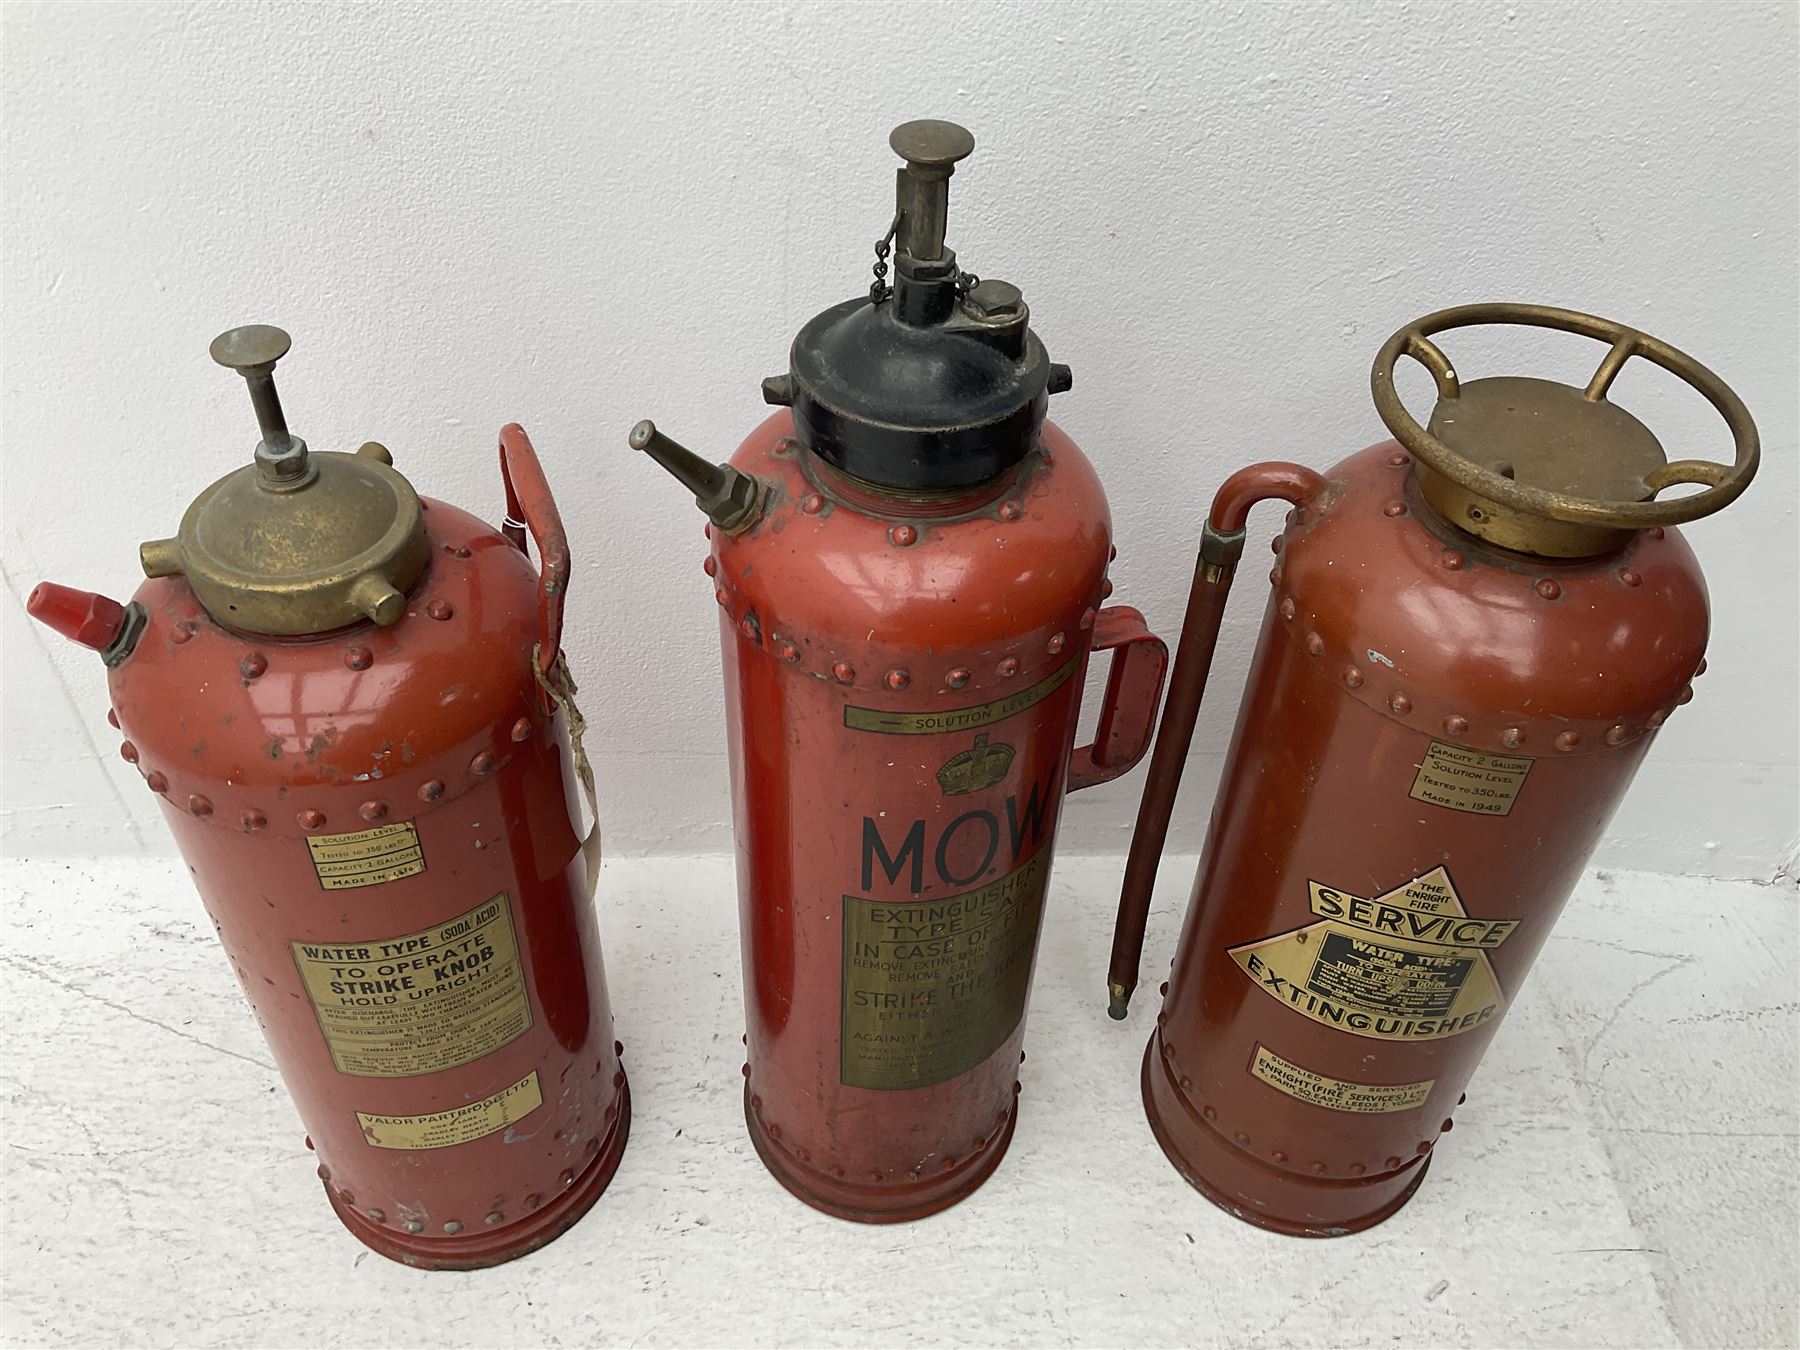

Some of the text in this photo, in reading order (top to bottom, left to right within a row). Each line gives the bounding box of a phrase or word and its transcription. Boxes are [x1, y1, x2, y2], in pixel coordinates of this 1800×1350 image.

[916, 691, 1041, 729] SOLUTION LEVEL
[1431, 745, 1528, 770] CAPACITY 2 GALLONS
[1423, 775, 1456, 791] TESTED
[1432, 761, 1515, 784] SOLUTION LEVEL
[1422, 791, 1450, 804] MADE
[1472, 802, 1502, 812] 1949
[321, 826, 397, 844] SOLUTION LEVEL
[320, 852, 349, 860] TESTED
[320, 864, 362, 873] CAPACITY
[332, 877, 366, 886] MADE
[870, 860, 1036, 923] EXTINGUISHER
[1420, 882, 1446, 894] THE
[1405, 889, 1451, 904] ENRIGHT
[1409, 900, 1440, 912] FIRE
[1317, 887, 1512, 947] SERVICE
[301, 903, 501, 960] WATER TYPE (SODA ACID)
[887, 918, 963, 939] TYPE
[855, 942, 880, 959] IN
[893, 939, 956, 960] CASE
[967, 922, 993, 945] OF
[1352, 939, 1404, 963] WATER
[330, 933, 486, 979] TO OPERATE
[853, 958, 905, 971] REMOVE
[1358, 960, 1374, 969] TO
[330, 946, 495, 995] STRIKE KNOB
[889, 970, 942, 983] REMOVE
[946, 969, 975, 985] AND
[1336, 961, 1363, 976] TURN
[340, 962, 493, 1006] HOLD UPRIGHT
[424, 986, 476, 1007] EXTINGUISHER
[481, 974, 499, 985] MUST
[468, 984, 493, 998] WATER
[853, 989, 940, 1009] STRIKE
[949, 972, 987, 1000] THE
[1247, 953, 1497, 1037] EXTINGUISHER
[350, 1028, 404, 1036] EXTINGUISHER
[416, 1022, 437, 1030] MADE
[453, 1006, 481, 1020] BRITISH
[879, 1009, 943, 1021] EITHER
[852, 1032, 917, 1043] AGAINST
[1259, 1058, 1311, 1089] ENRIGHT
[1312, 1083, 1344, 1099] (FIRE
[1349, 1091, 1407, 1102] SERVICES)
[1271, 1056, 1322, 1082] SUPPLIED
[1334, 1082, 1357, 1090] AND
[1369, 1084, 1421, 1092] SERVICED
[1270, 1074, 1296, 1091] PARK
[1345, 1100, 1378, 1108] LEEDS
[1293, 1091, 1322, 1104] PHONE
[365, 1116, 413, 1126] VALOR
[506, 1079, 529, 1097] LTD
